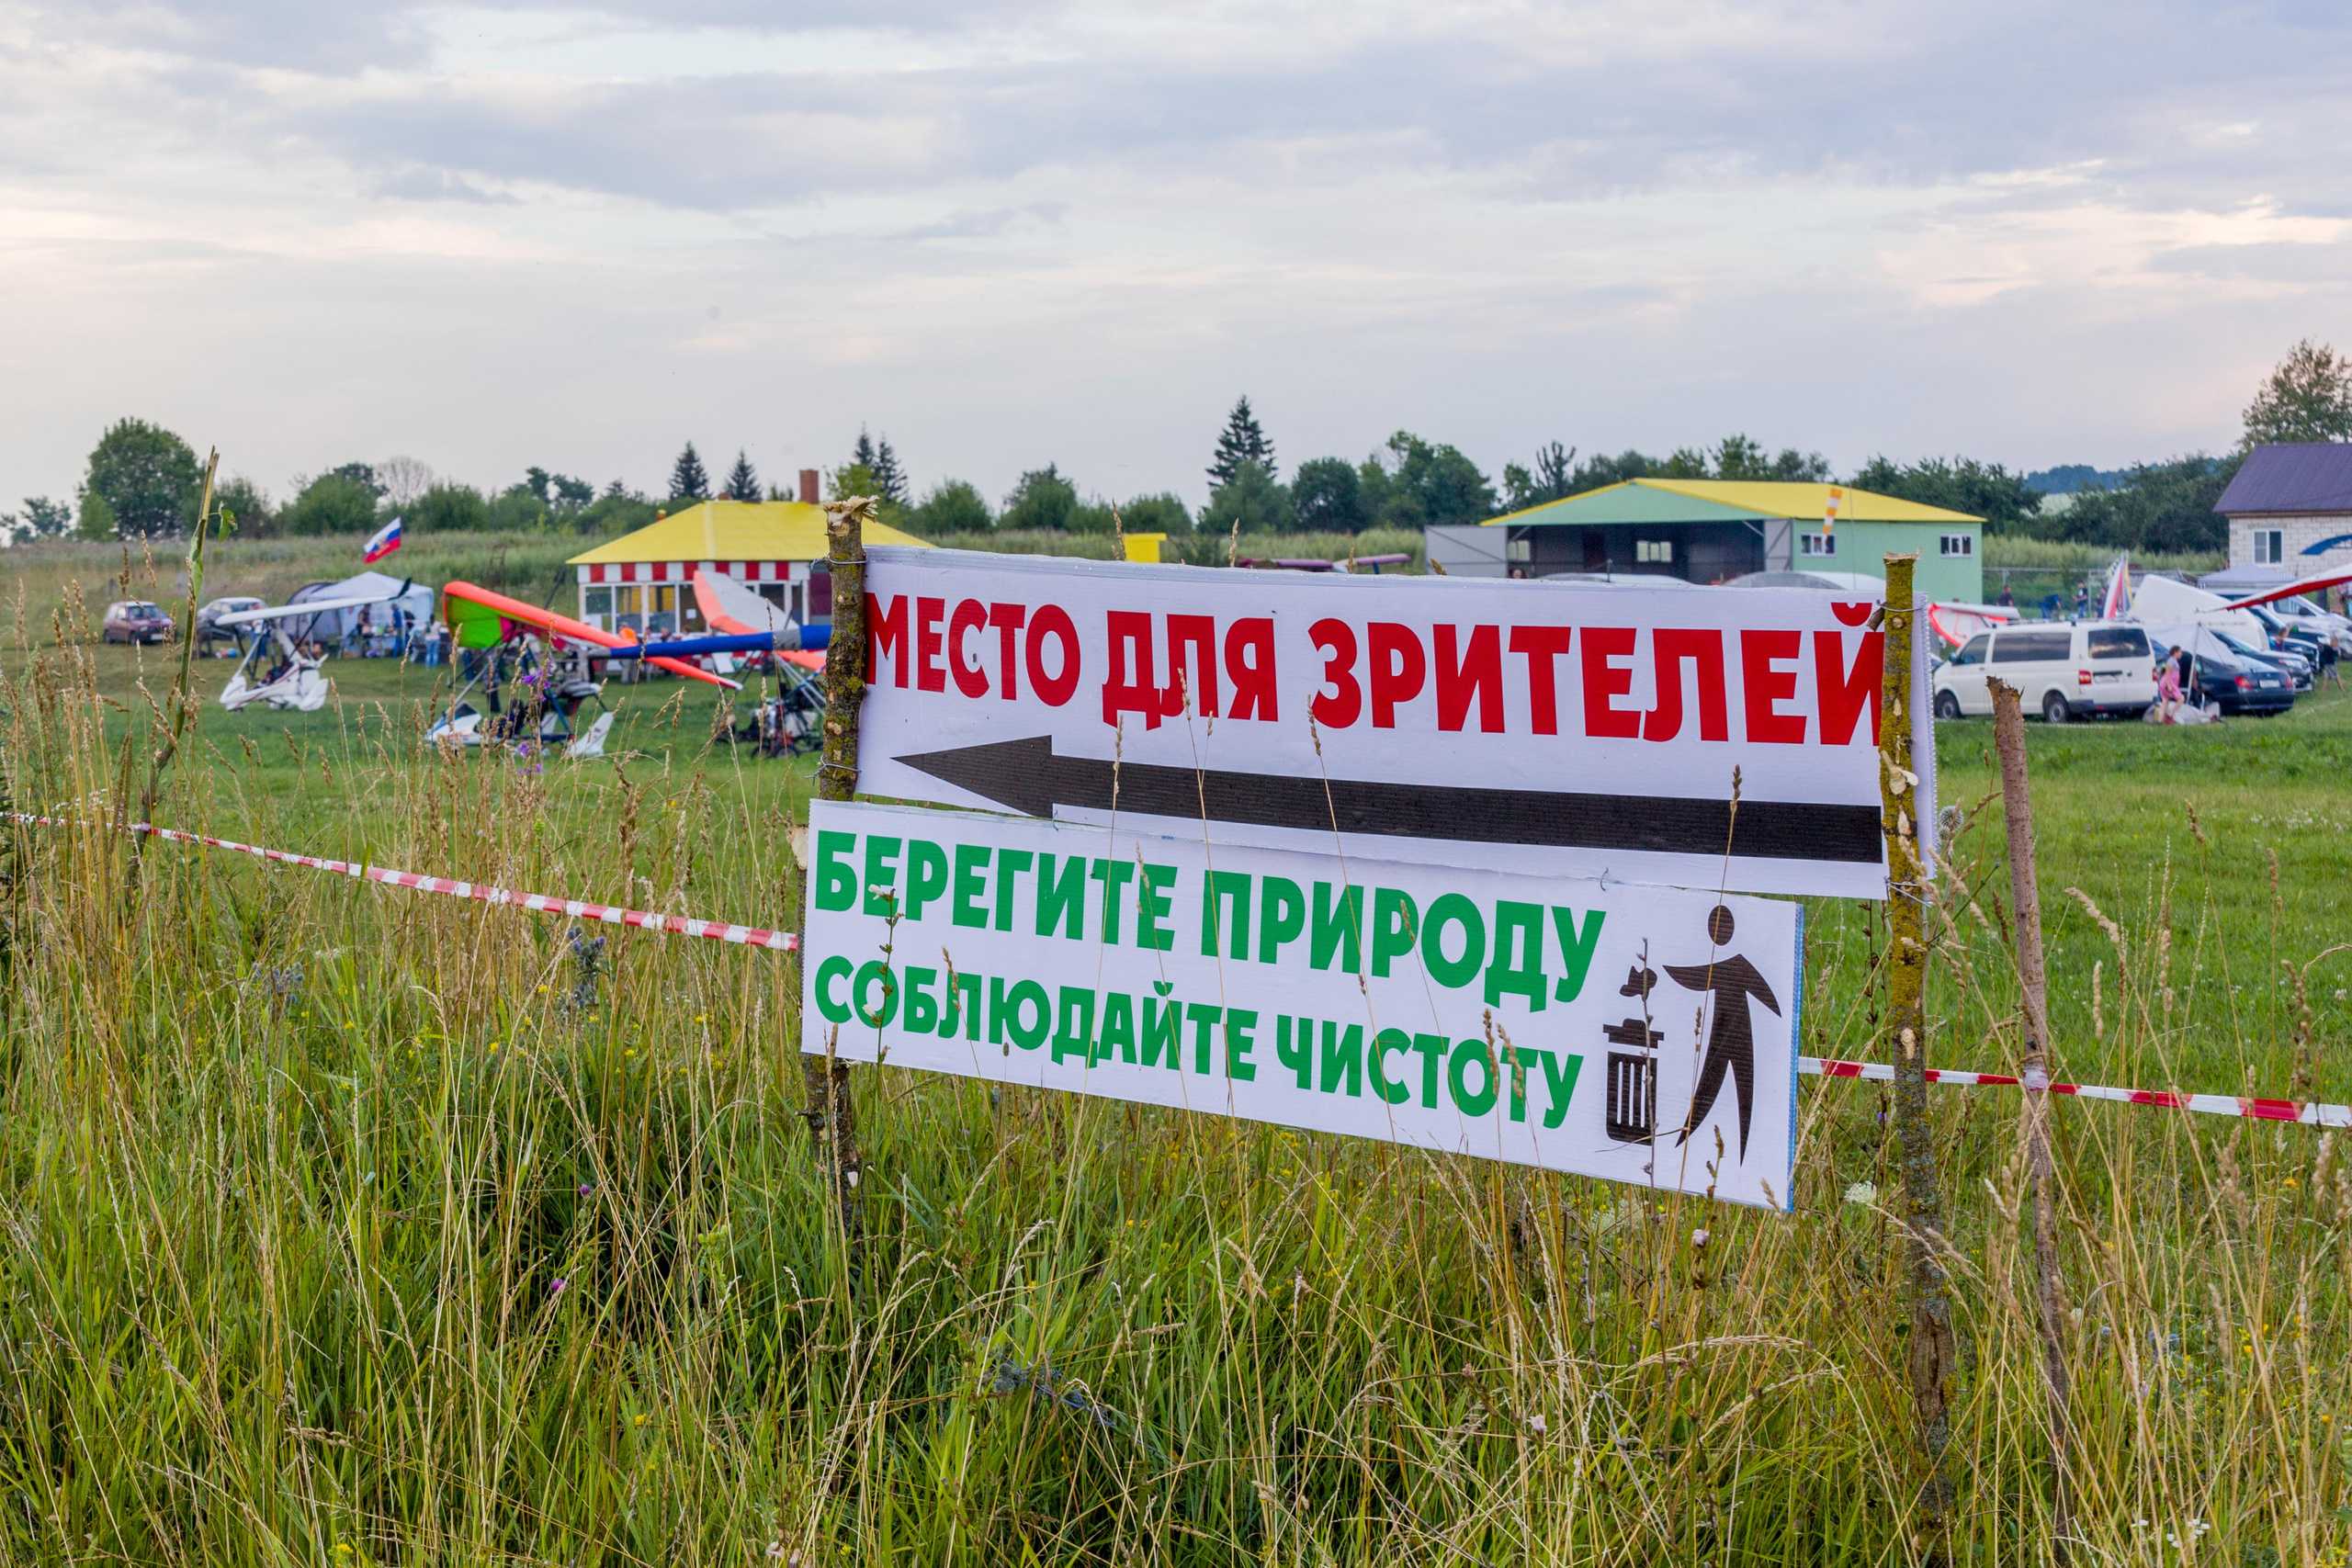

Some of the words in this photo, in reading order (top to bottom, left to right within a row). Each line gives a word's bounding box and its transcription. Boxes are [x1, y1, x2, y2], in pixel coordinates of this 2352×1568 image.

[865, 592, 1081, 706] МЕСТО
[1102, 610, 1278, 730] ДЛЯ
[1307, 602, 1884, 747] ЗРИТЕЛЕЙ
[815, 829, 1178, 952] БЕРЕГИТЕ
[1201, 870, 1606, 1013] ПРИРОДУ
[814, 955, 1259, 1082] СОБЛЮДАЙТЕ
[1276, 1014, 1584, 1129] ЧИСТОТУ
